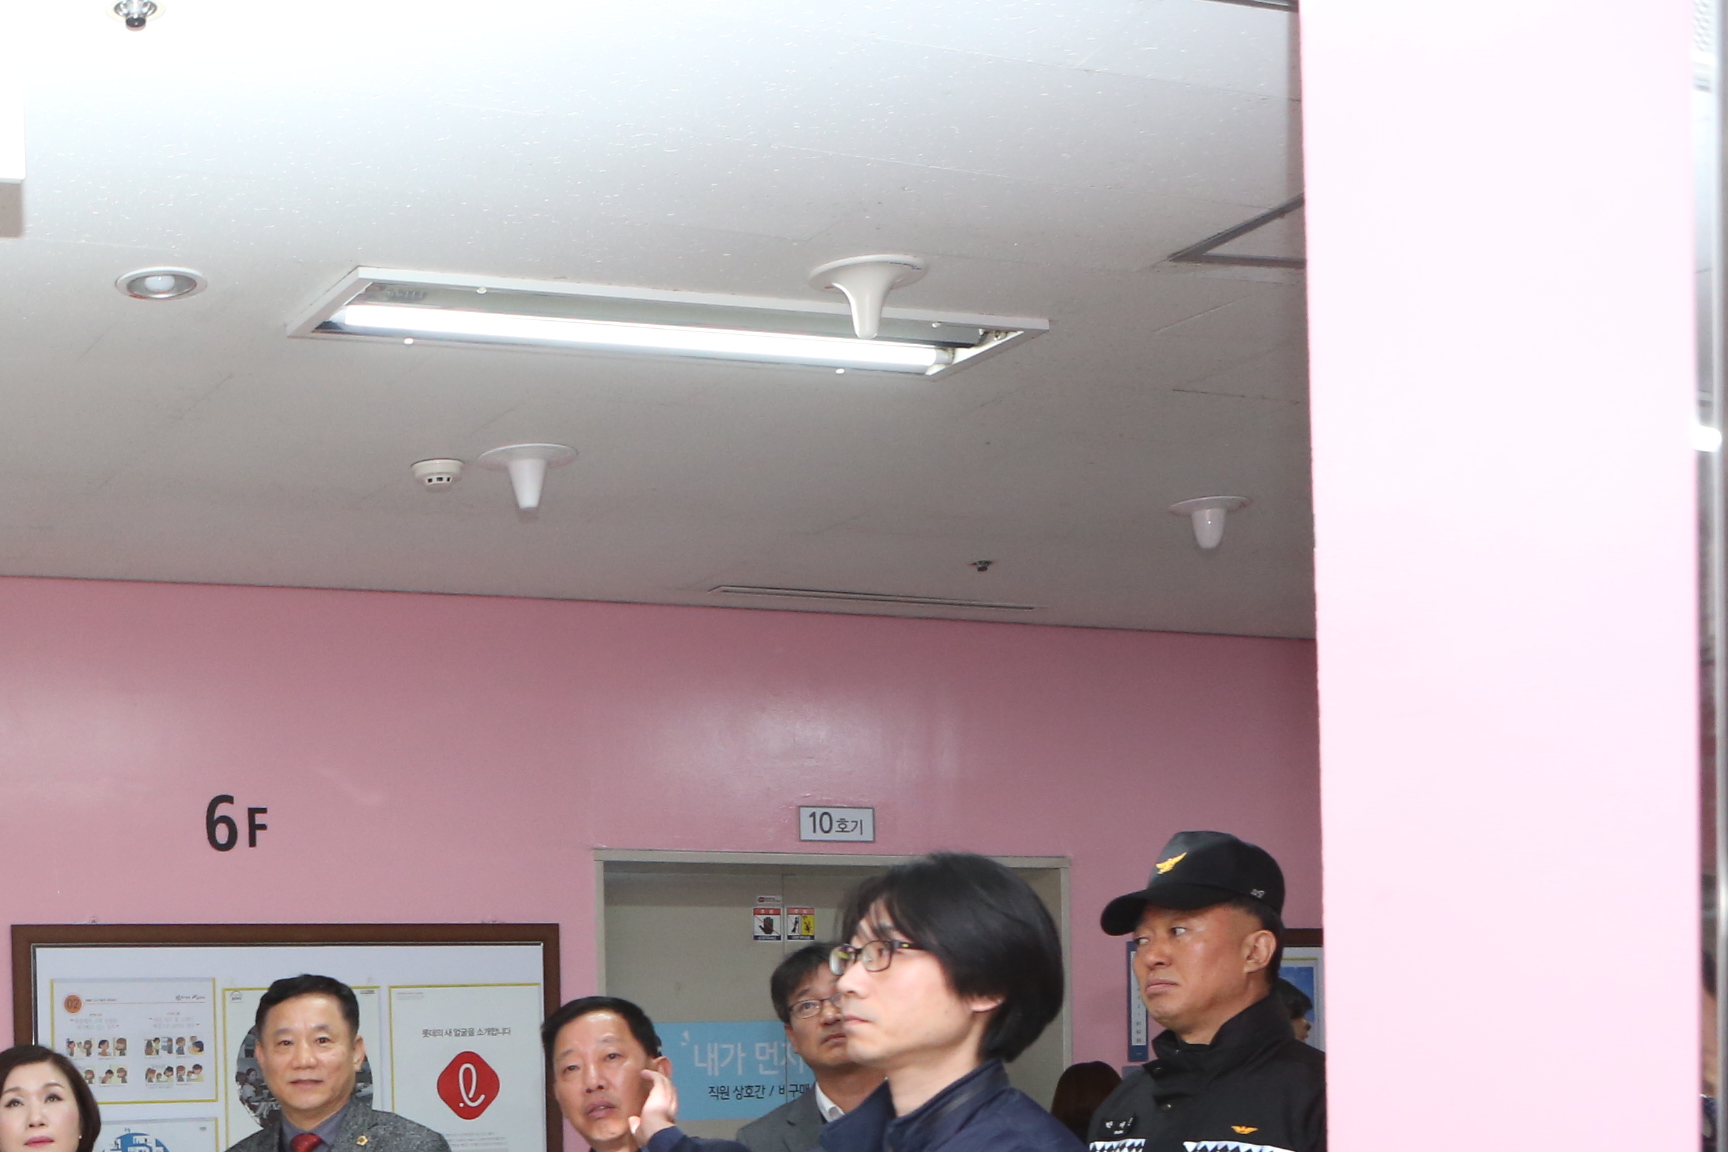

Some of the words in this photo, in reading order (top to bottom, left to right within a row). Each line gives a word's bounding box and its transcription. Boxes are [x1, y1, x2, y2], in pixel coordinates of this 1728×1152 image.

[205, 793, 268, 853] 6F
[708, 1084, 730, 1100] 직원
[732, 1084, 766, 1100] 상호간
